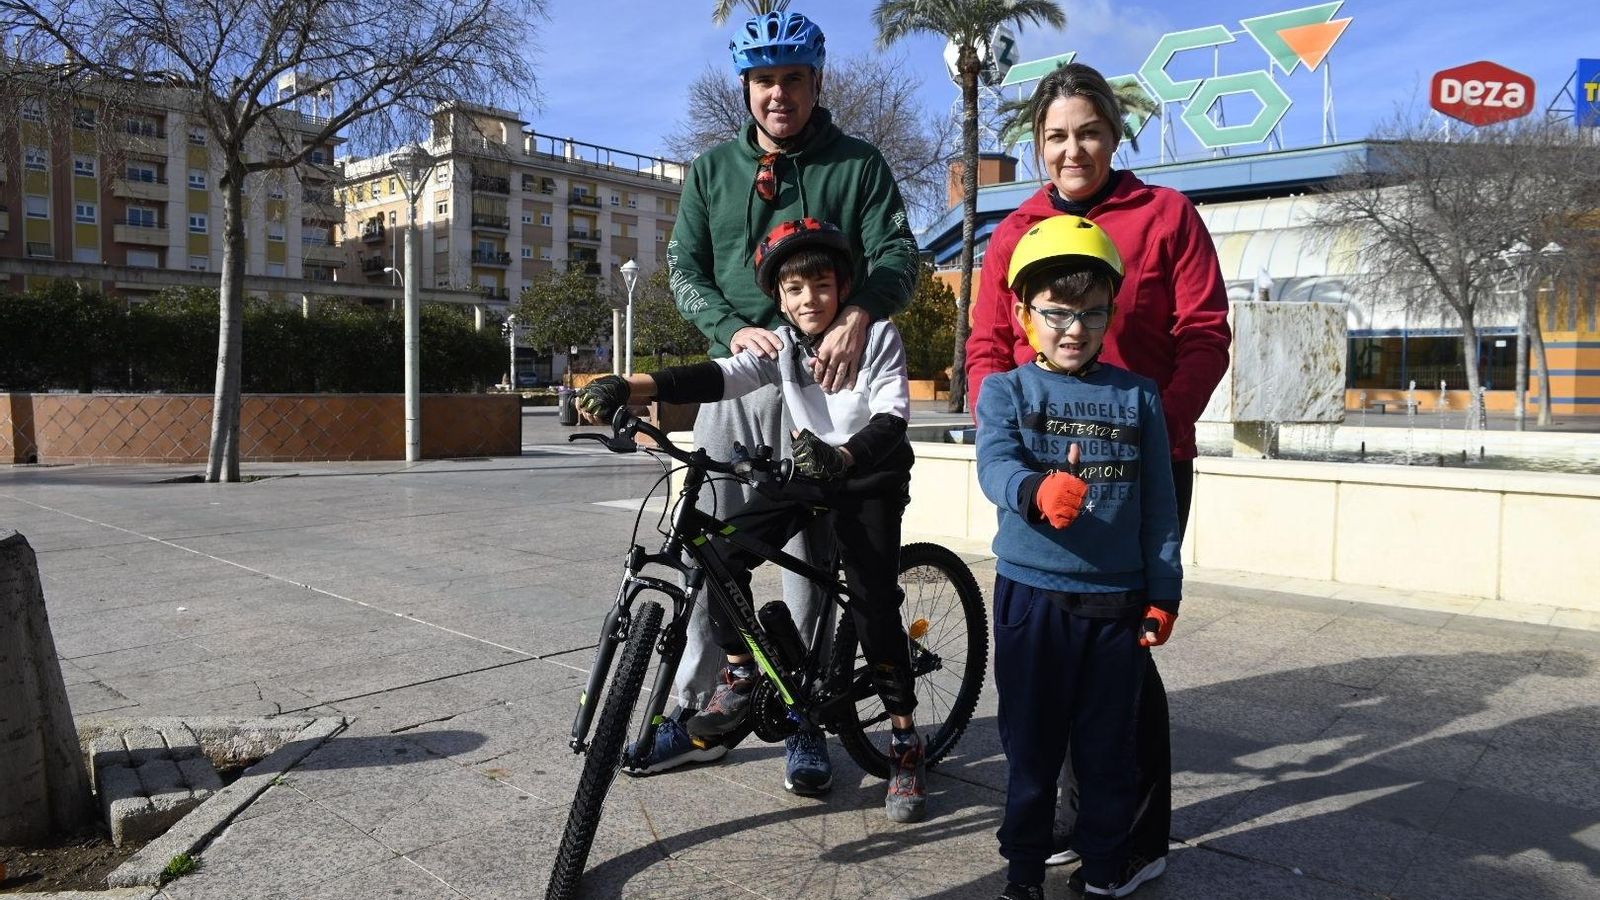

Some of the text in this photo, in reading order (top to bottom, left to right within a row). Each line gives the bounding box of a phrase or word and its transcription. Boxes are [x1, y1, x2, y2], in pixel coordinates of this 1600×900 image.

[1063, 402, 1137, 419] ANGELES
[1046, 420, 1120, 439] STATESIDE
[1031, 437, 1060, 455] LOS
